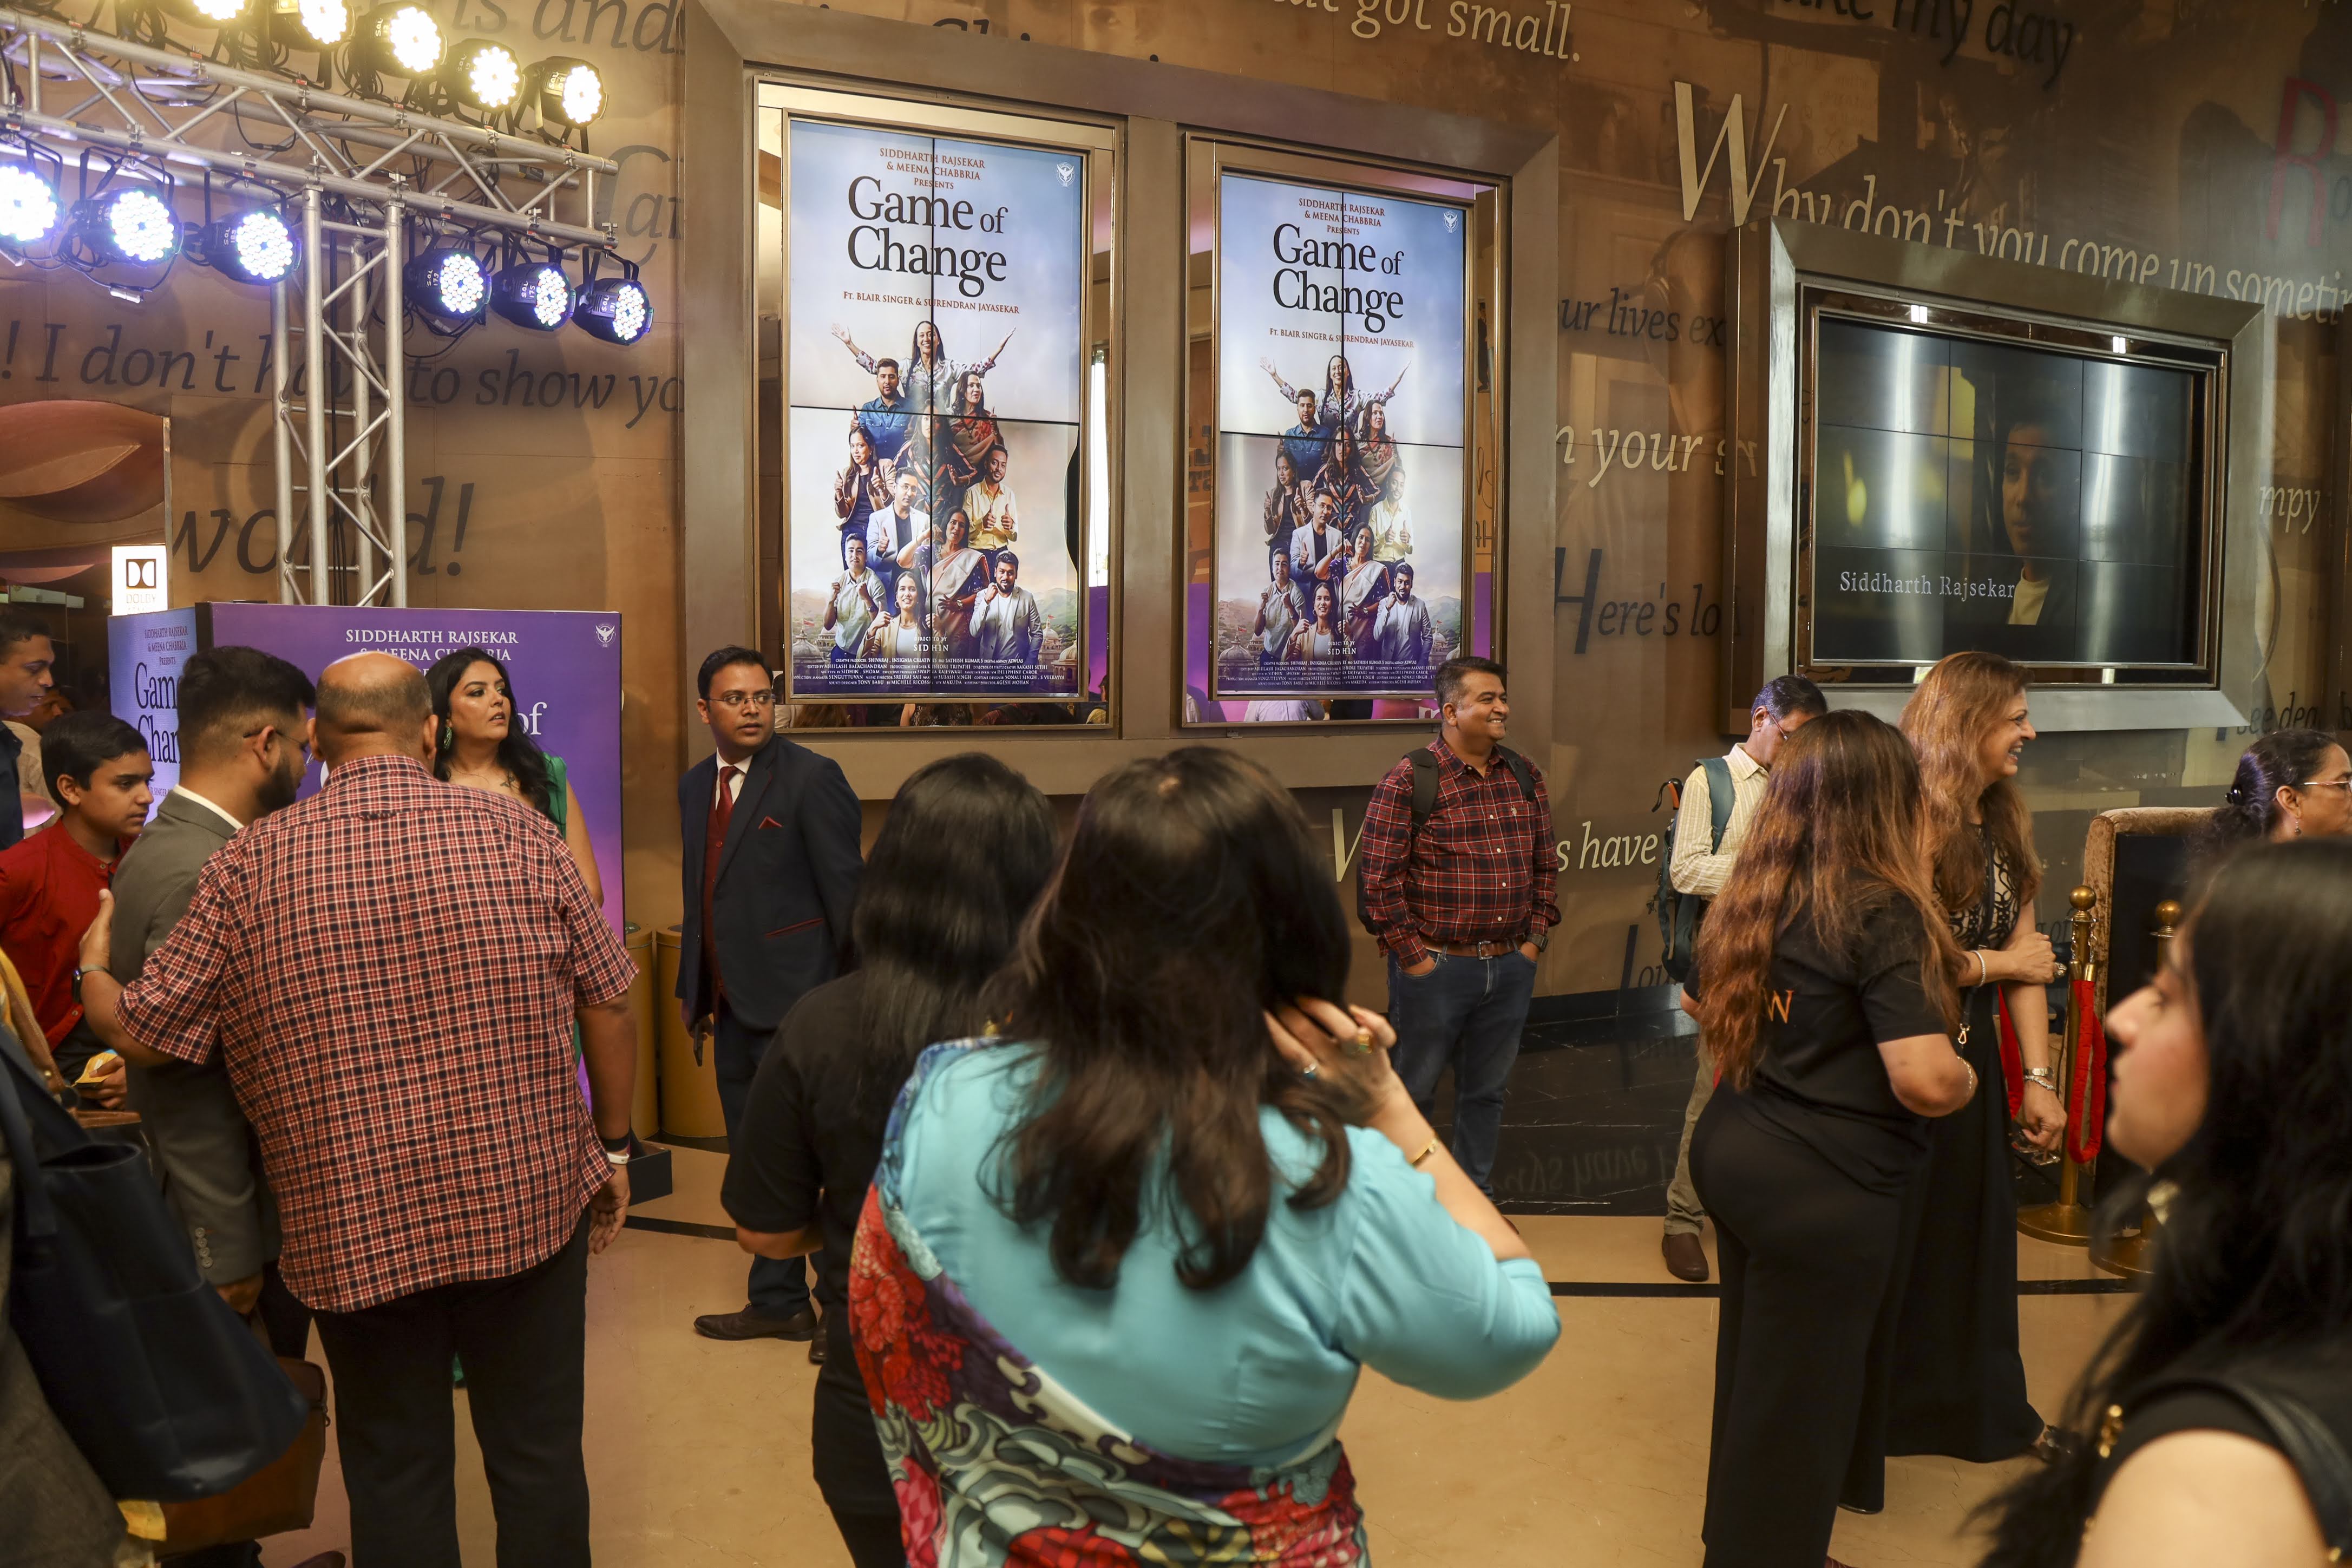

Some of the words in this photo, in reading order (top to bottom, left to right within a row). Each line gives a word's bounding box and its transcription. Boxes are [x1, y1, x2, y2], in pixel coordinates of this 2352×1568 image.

[1447, 0, 1581, 62] small.
[880, 148, 938, 163] SIDDHARTH
[942, 155, 985, 168] RAJSEKAR
[887, 161, 894, 170] &
[896, 163, 929, 174] MEENA
[933, 166, 980, 180] CHABBRIA
[848, 175, 973, 231] Game
[980, 207, 1008, 234] of
[1299, 198, 1347, 211] SIDDHARTH
[1350, 205, 1385, 216] RAJSEKAR
[1313, 212, 1340, 222] MEENA
[1343, 215, 1381, 226] CHABBRIA
[847, 225, 1007, 297] Change
[1273, 223, 1376, 272] Game
[1381, 251, 1404, 275] of
[857, 292, 881, 302] BLAIR
[882, 295, 914, 305] SINGER
[924, 298, 975, 310] SURENDRAN
[978, 303, 1020, 314] JAYASEKAR
[1273, 268, 1404, 333] Change
[1557, 297, 1601, 335] ur
[1608, 287, 1679, 342] lives
[35, 324, 68, 382] I
[81, 327, 241, 394] don't
[1281, 330, 1300, 338] BLAIR
[1302, 332, 1327, 341] SINGER
[1335, 334, 1378, 345] SURENDRAN
[1381, 338, 1414, 348] JAYASEKAR
[408, 358, 460, 404] to
[476, 349, 615, 411] show
[1588, 426, 1703, 488] your
[1555, 547, 1680, 654] Here's
[1840, 572, 1931, 595] Siddharth
[1939, 576, 2015, 602] Rajsekar
[144, 628, 168, 639] SIDDHARTH
[168, 626, 188, 639] RAJSEKAR
[152, 641, 166, 652] MEENA
[346, 629, 443, 644] SIDDHARTH
[448, 631, 519, 647] RAJSEKAR
[913, 644, 949, 652] SIDHIN
[135, 662, 179, 709] Gam
[1578, 821, 1658, 870] have
